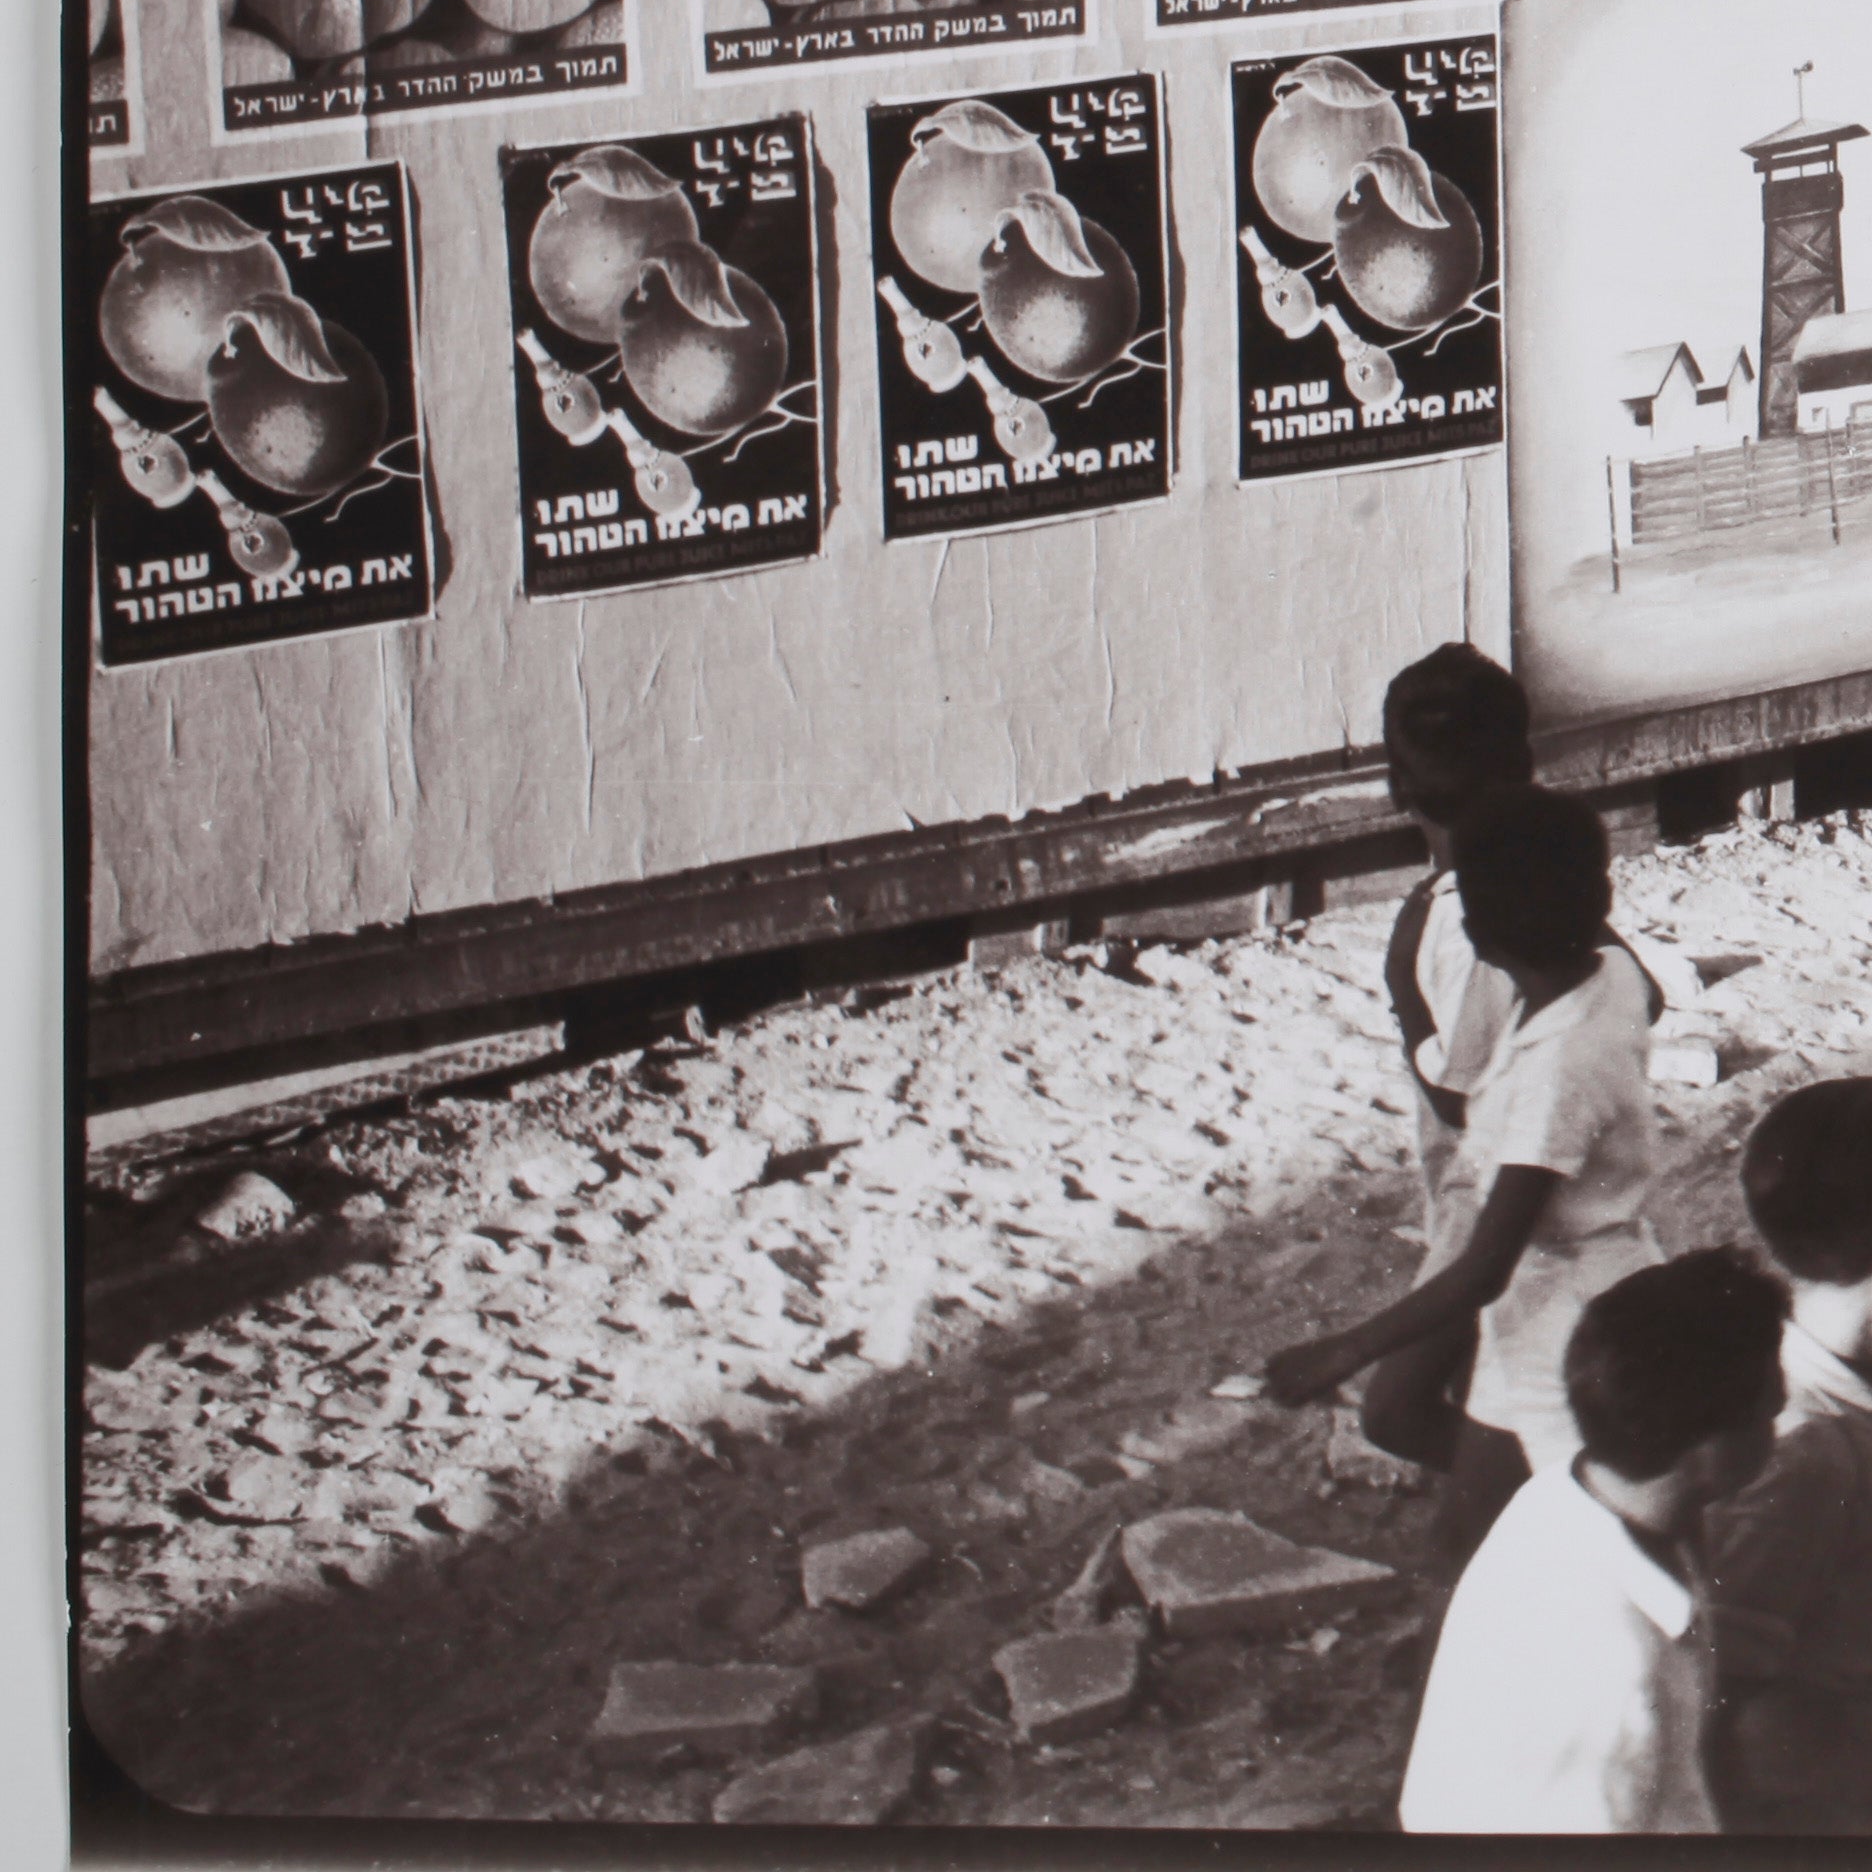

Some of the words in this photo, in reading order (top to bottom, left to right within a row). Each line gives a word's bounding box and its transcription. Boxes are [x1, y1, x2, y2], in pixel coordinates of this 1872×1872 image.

[934, 15, 1007, 43] במשק
[1017, 6, 1076, 33] תמוך
[468, 63, 543, 95] במשק
[556, 54, 617, 83] תמוך
[398, 75, 458, 97] ההדר
[1251, 379, 1330, 413] שתו
[1452, 385, 1496, 415] את
[1251, 407, 1354, 444] הטהור
[894, 434, 979, 470] שתו
[1109, 437, 1155, 464] את
[894, 462, 1006, 501] הטהור
[535, 488, 619, 526] שתו
[758, 494, 807, 524] את
[534, 517, 648, 559] הטהור
[117, 552, 210, 591] שתו
[361, 553, 412, 584] את
[116, 582, 241, 624] הטהור
